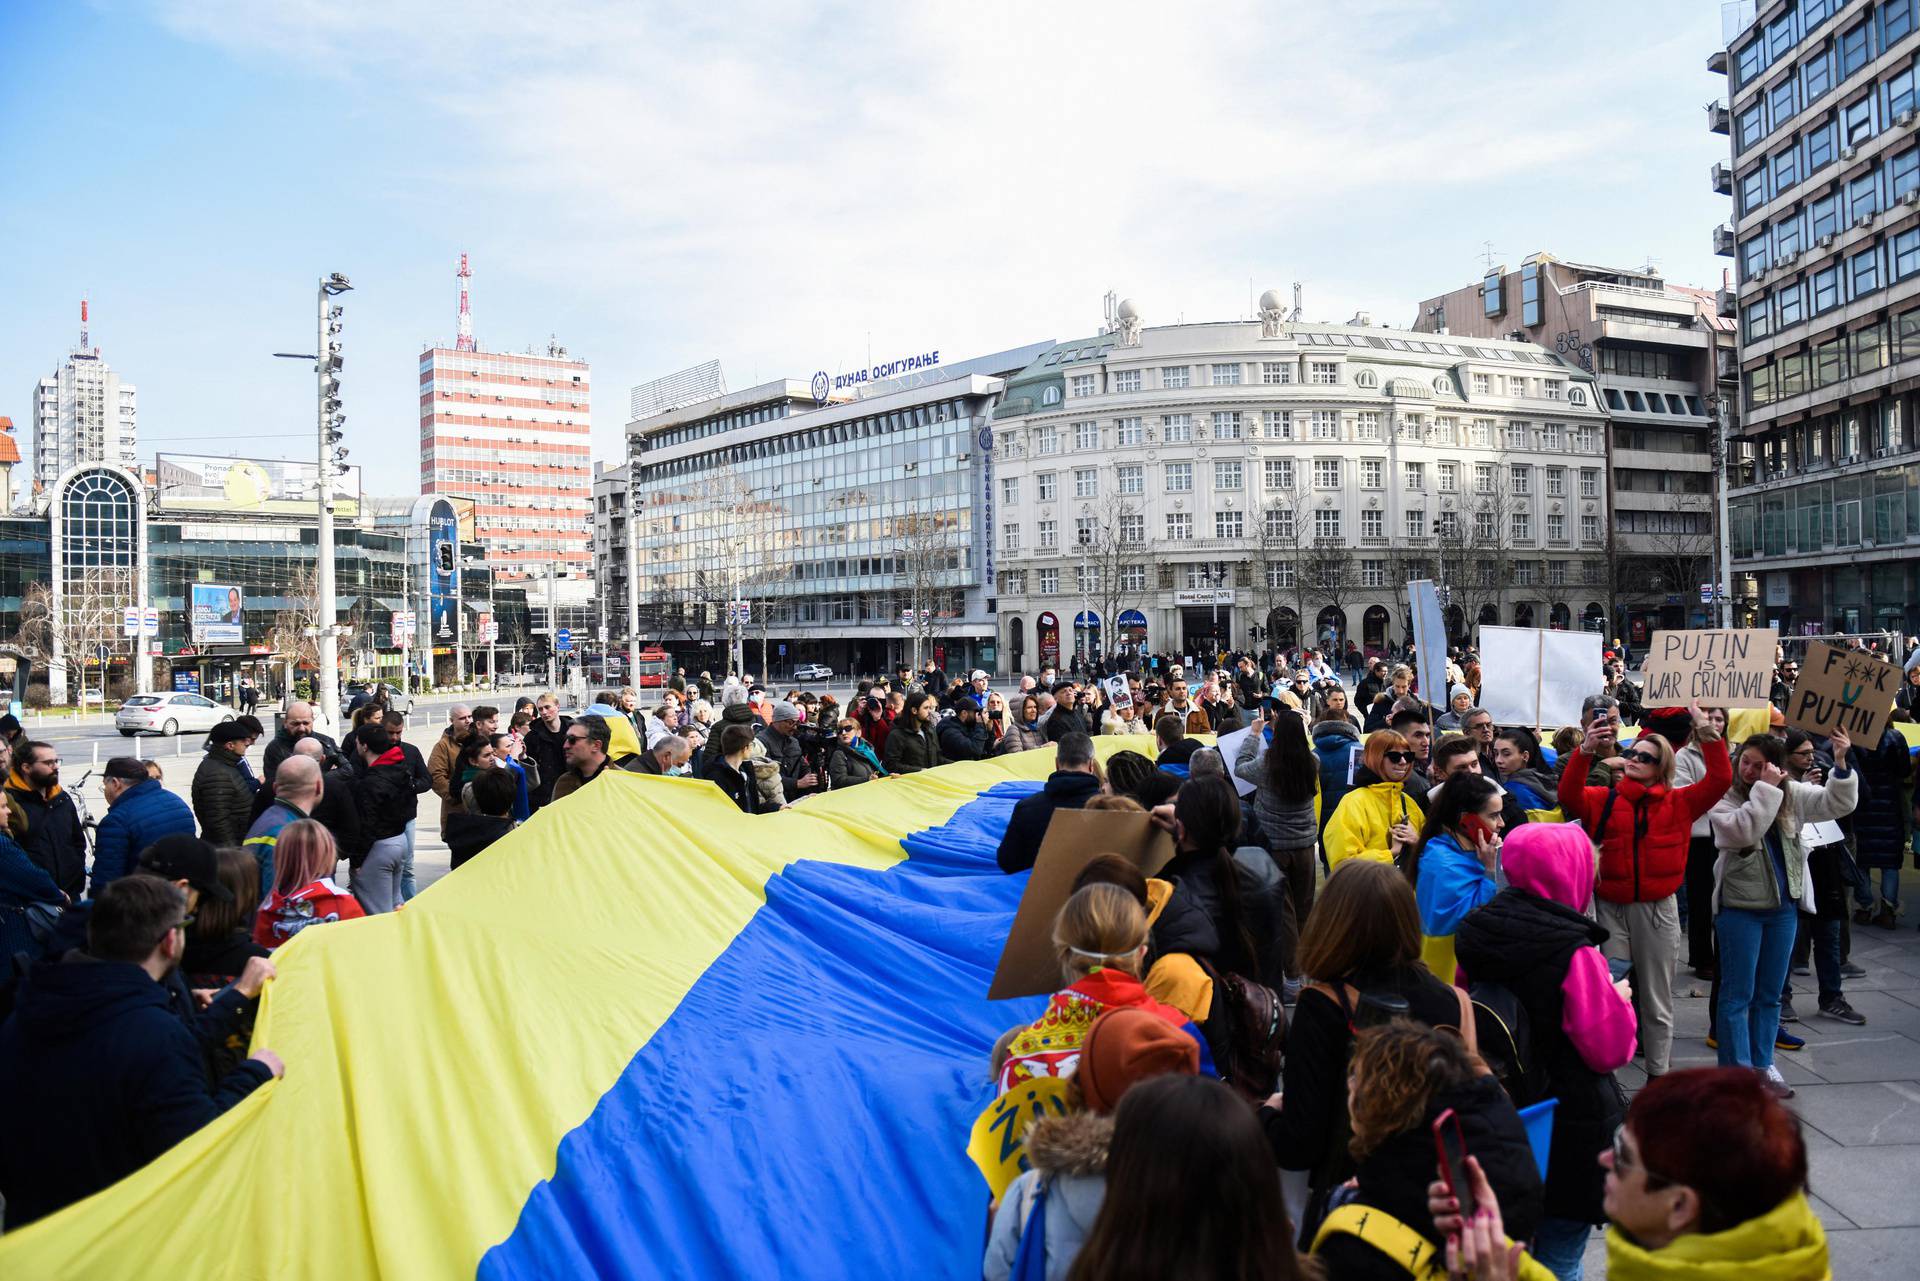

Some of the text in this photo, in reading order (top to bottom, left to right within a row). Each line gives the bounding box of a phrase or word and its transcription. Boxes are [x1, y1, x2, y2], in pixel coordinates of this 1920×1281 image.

[835, 351, 940, 390] ДУНАВ ОСИГУРАЊЕ
[1665, 633, 1749, 660] PUTIN
[1699, 660, 1735, 671] IS A
[1649, 671, 1769, 700] WAR CRIMINAL
[1797, 690, 1875, 735] PUTIN
